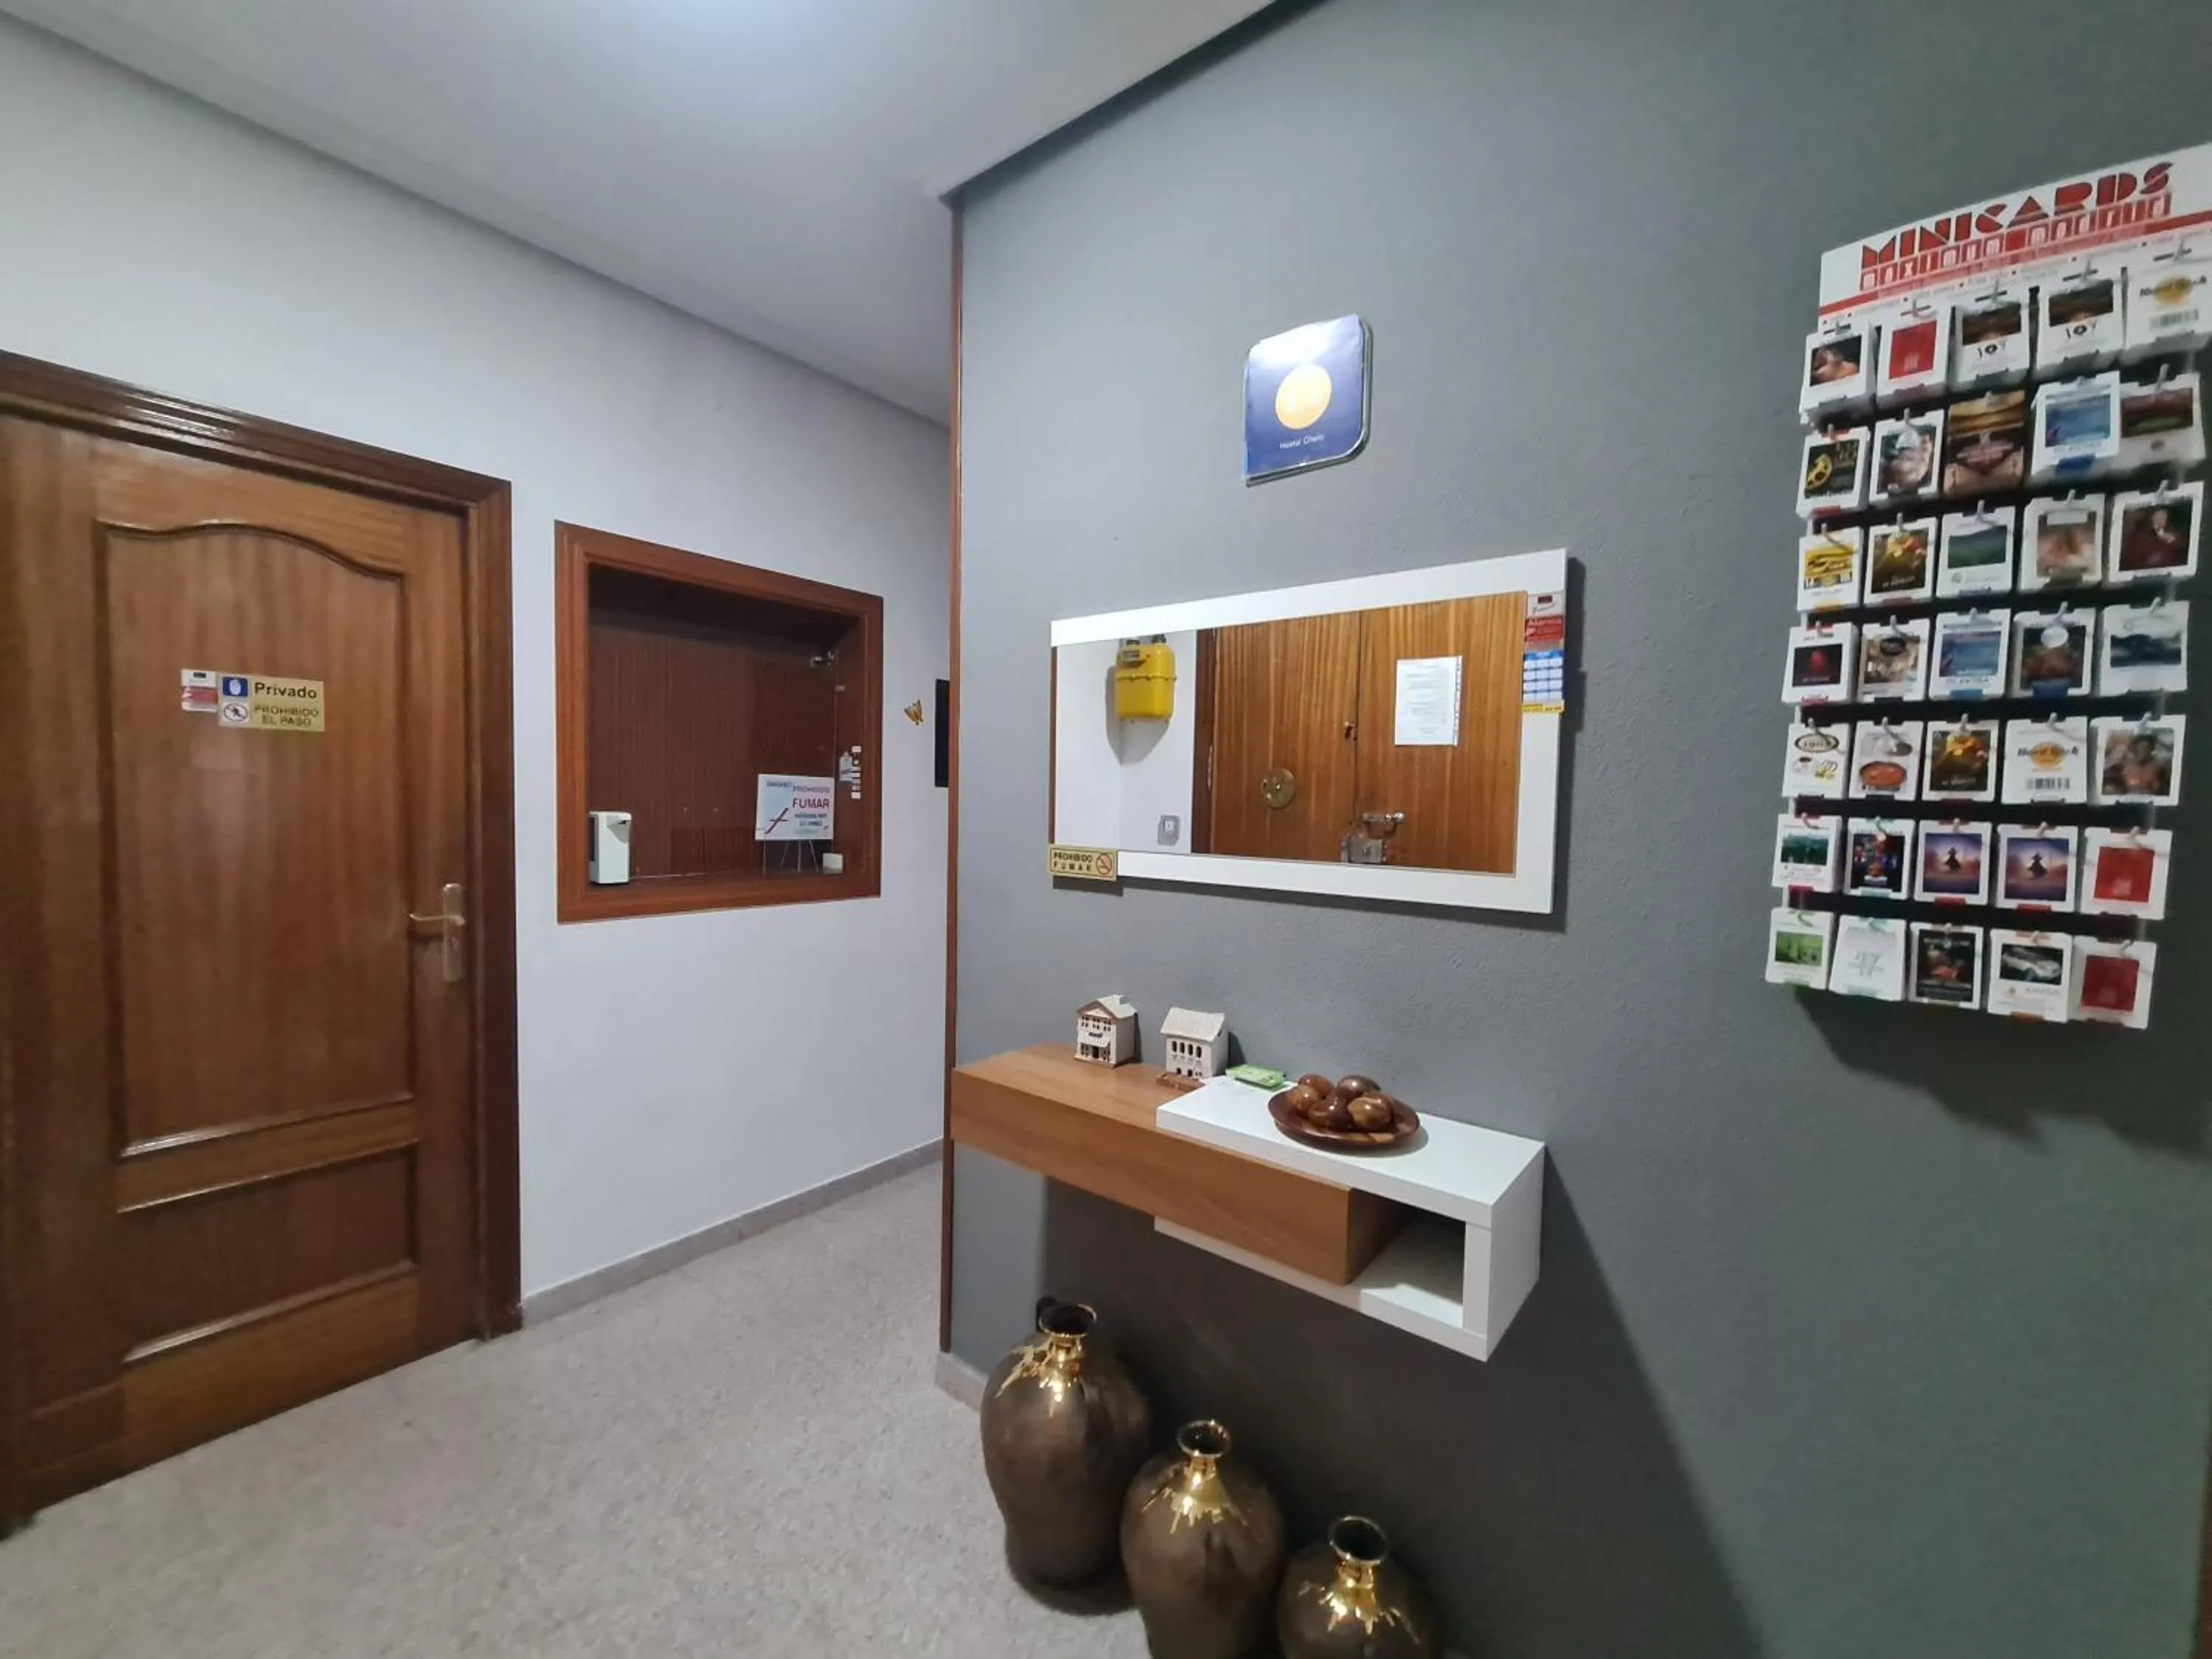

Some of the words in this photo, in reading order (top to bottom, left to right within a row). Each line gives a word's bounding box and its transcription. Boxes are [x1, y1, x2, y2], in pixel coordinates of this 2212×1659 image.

[1862, 161, 2174, 269] MINICARDS
[254, 683, 317, 698] Privado
[254, 704, 319, 718] PROHIBIDO
[262, 716, 277, 726] EL
[280, 717, 312, 727] PASO
[793, 798, 830, 808] FUMAR
[1053, 852, 1093, 863] PROHIBIDO
[1054, 860, 1091, 872] FUMAR
